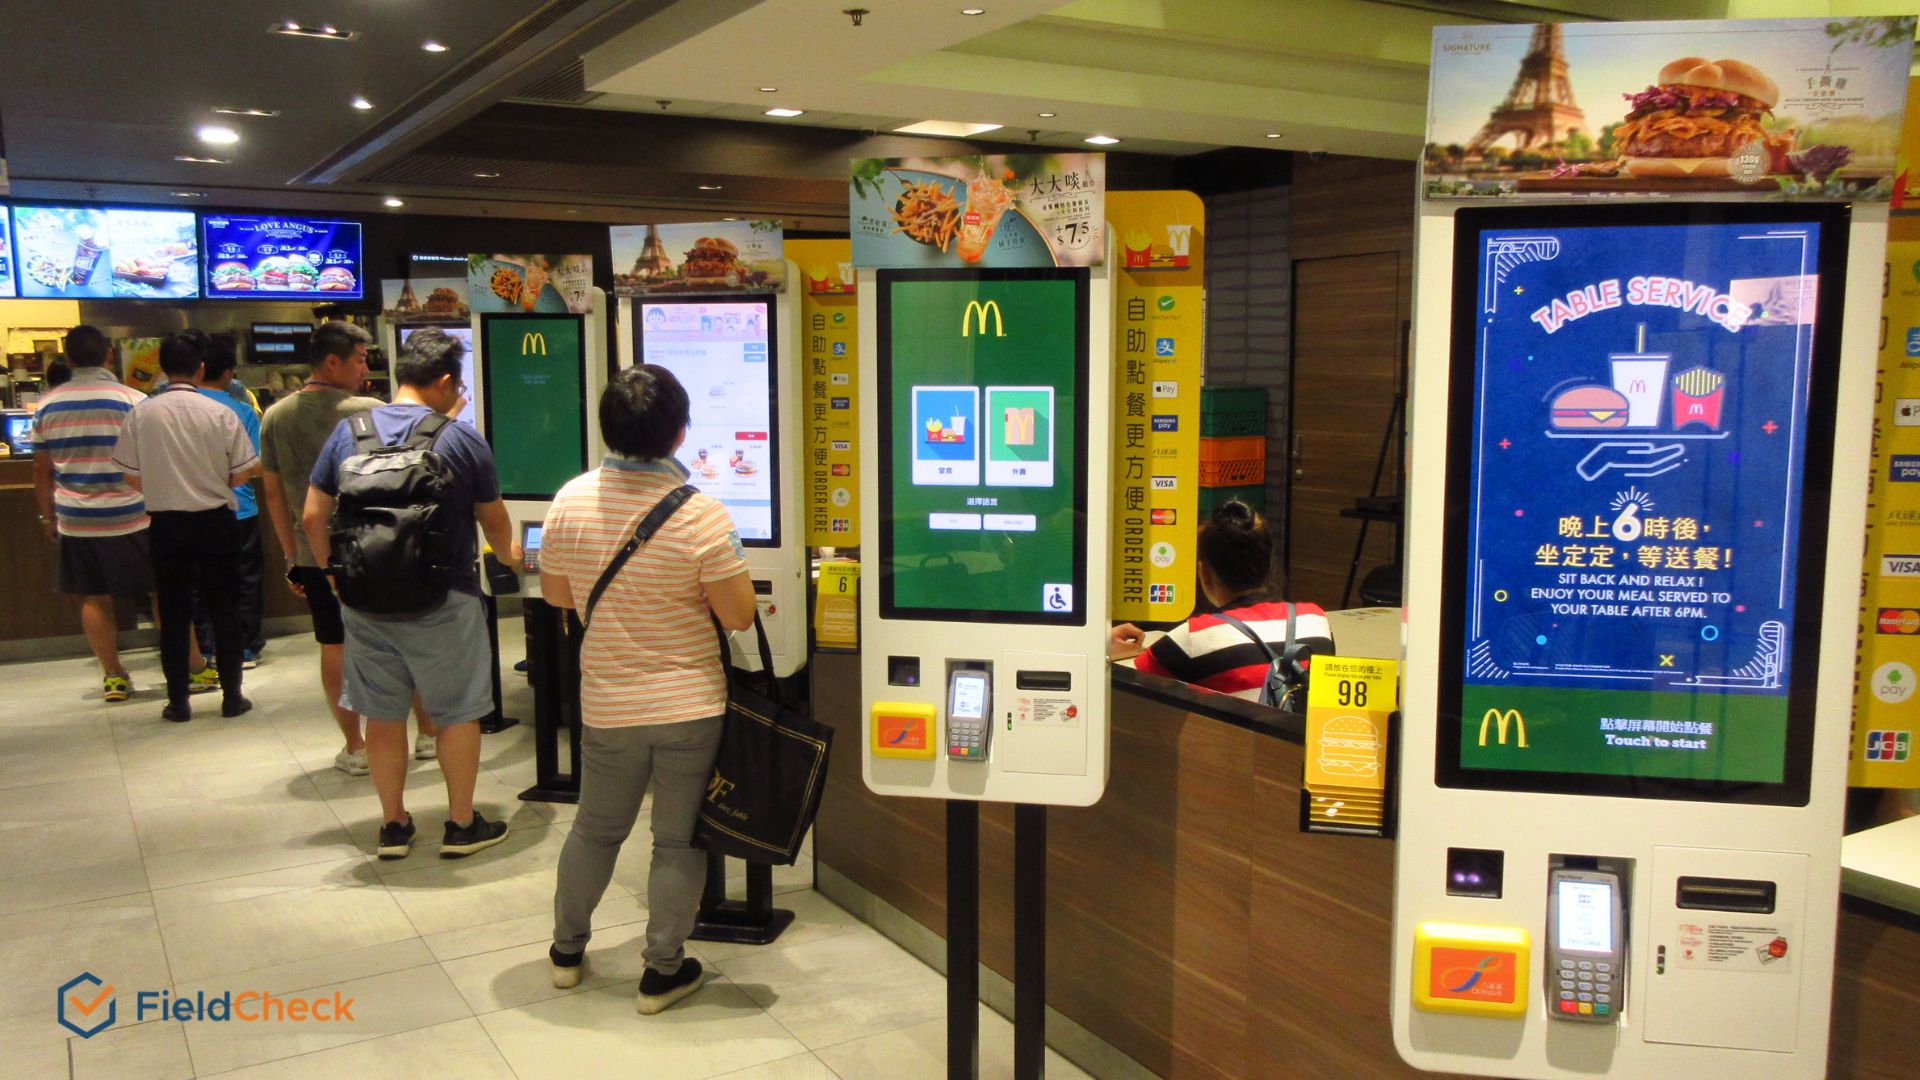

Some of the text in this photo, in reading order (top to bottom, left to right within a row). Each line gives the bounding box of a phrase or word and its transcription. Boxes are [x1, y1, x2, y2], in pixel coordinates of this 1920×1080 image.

[1443, 43, 1491, 52] SIGNATURE
[1030, 172, 1081, 196] 大大啖
[254, 221, 281, 233] LOVE
[282, 221, 315, 235] ANGUS
[1531, 276, 1752, 335] TABLE SERVICE
[812, 313, 828, 467] 自助點餐更方便
[1163, 385, 1176, 394] Pay
[1125, 296, 1147, 511] 自助點餐更方便
[1155, 479, 1174, 488] VISA
[814, 470, 828, 533] ORDER HERE
[1124, 518, 1144, 604] ORDER HERE
[1155, 555, 1171, 564] pay
[839, 576, 847, 593] 6
[1558, 573, 1578, 585] SIT
[1580, 573, 1616, 586] BACK
[1619, 574, 1650, 587] AND
[1653, 575, 1695, 588] RELAX
[1530, 587, 1730, 604] ENJOY YOUR MEAL SERVED TO
[1550, 603, 1707, 619] YOUR TABLE AFTER 6PM.
[1338, 679, 1368, 708] 98
[1880, 684, 1906, 697] pay
[1600, 717, 1713, 737] 點擊屏幕開始點餐
[1605, 734, 1707, 750] Touch to start
